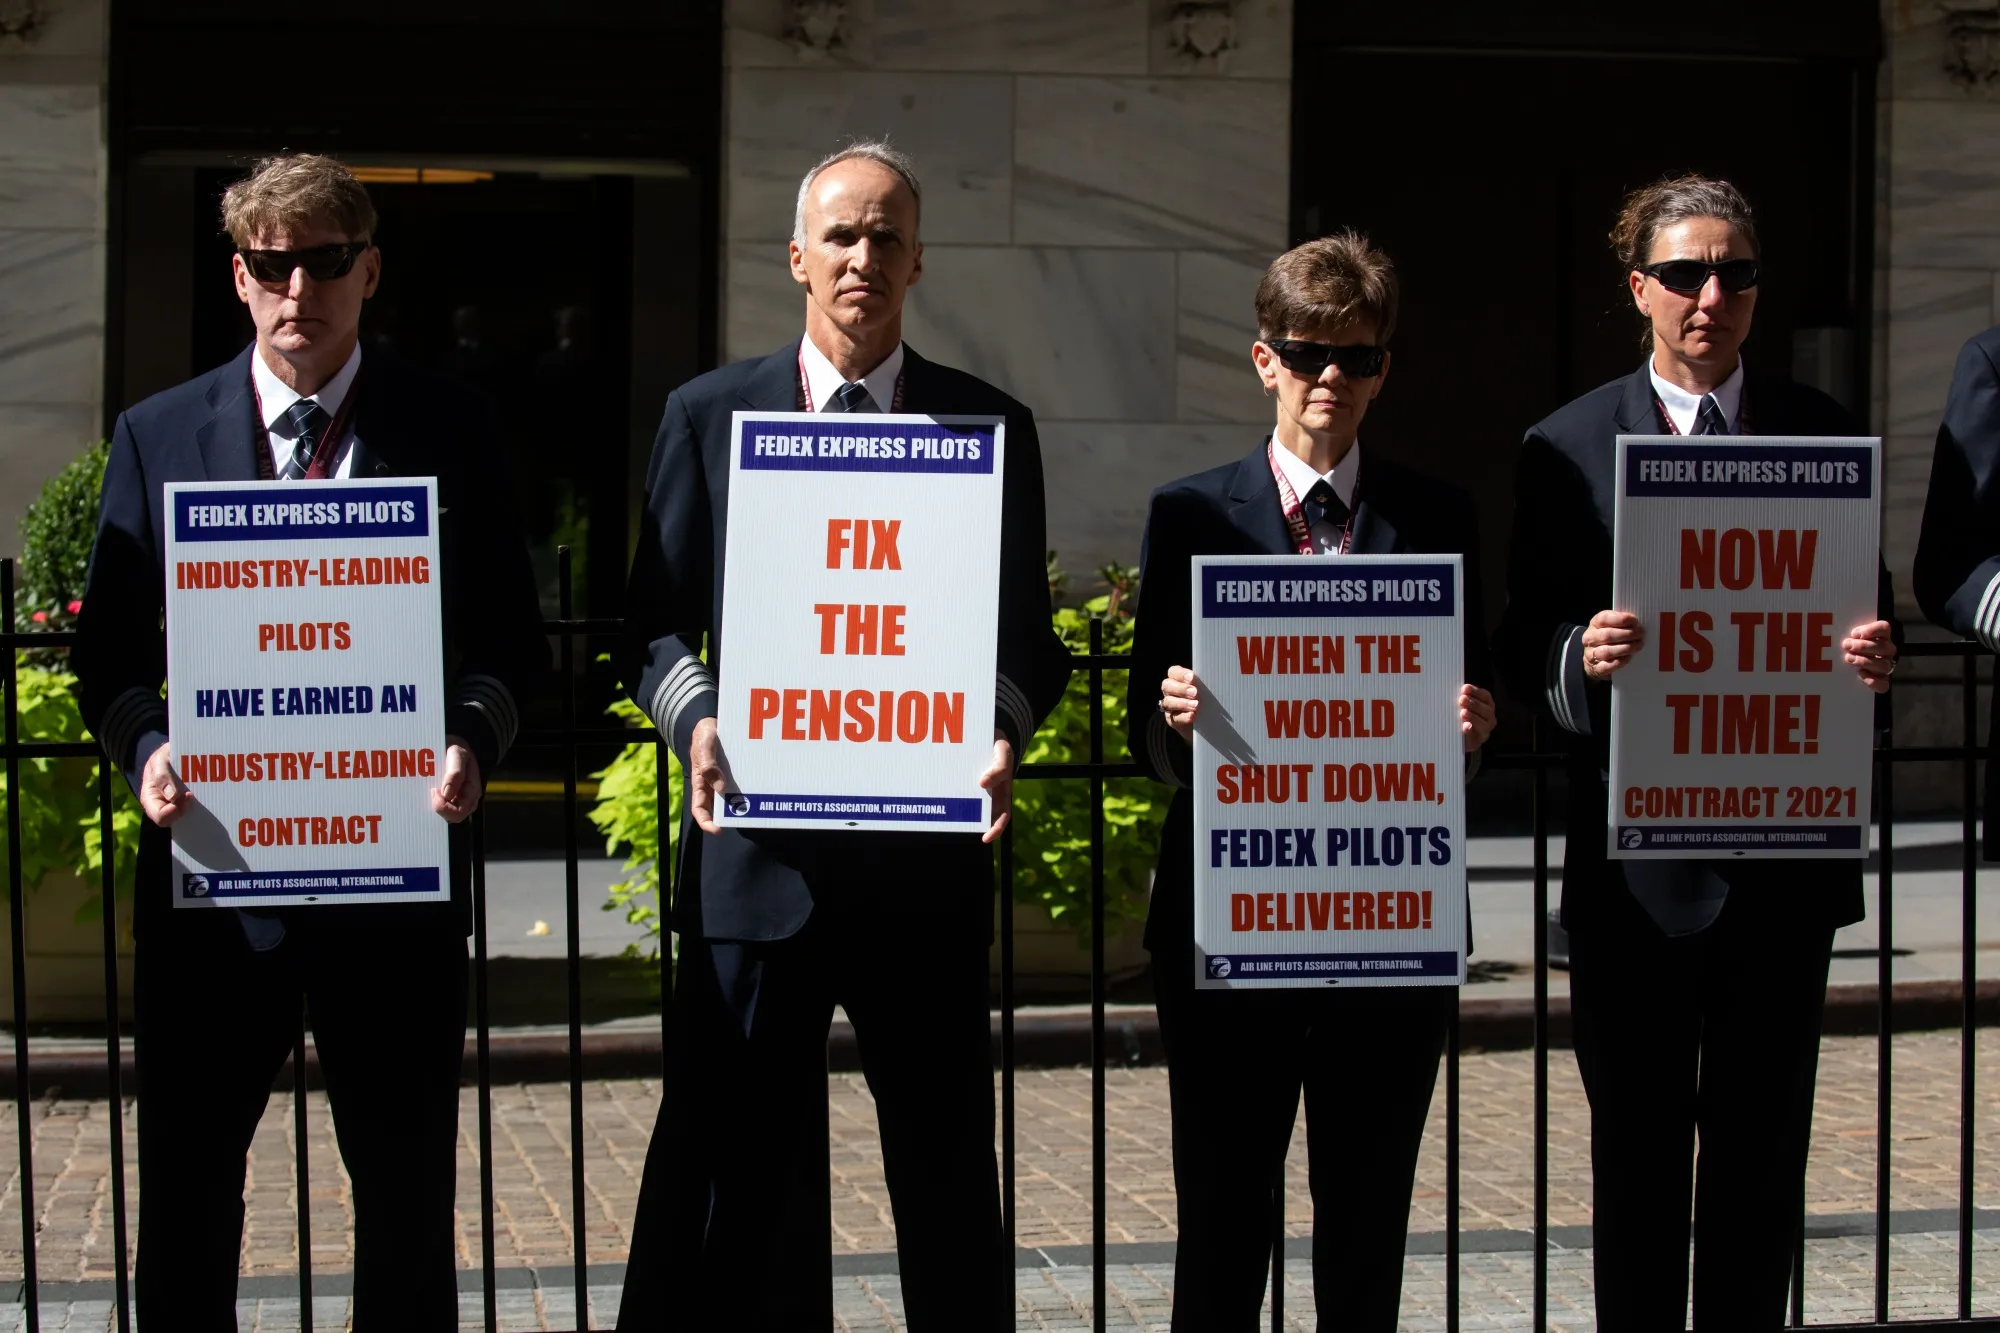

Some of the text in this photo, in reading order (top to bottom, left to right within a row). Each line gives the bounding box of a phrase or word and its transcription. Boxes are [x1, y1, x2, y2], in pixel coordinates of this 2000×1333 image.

[754, 435, 981, 460] FEDEX EXPRESS PILOTS
[1640, 460, 1859, 484] FEDEX EXPRESS PILOTS
[188, 500, 415, 528] FEDEX EXPRESS PILOTS
[1287, 511, 1309, 541] THE
[826, 518, 902, 571] FIX
[1679, 528, 1818, 591] NOW
[176, 555, 430, 590] INDUSTRY-LEADING
[1216, 578, 1441, 603] FEDEX EXPRESS PILOTS
[258, 621, 352, 652] PILOTS
[814, 603, 906, 656] THE
[1658, 610, 1834, 674] IS THE
[1237, 634, 1421, 675] WHEN THE
[196, 684, 417, 718] HAVE EARNED AN
[748, 688, 965, 744] PENSION
[1263, 699, 1395, 739] WORLD
[1665, 693, 1821, 756] TIME!
[180, 747, 436, 783] INDUSTRY-LEADING
[1216, 762, 1445, 805] SHUT DOWN,
[759, 801, 774, 811] AIR
[775, 801, 793, 812] LINE
[794, 802, 823, 812] PILOTS
[882, 803, 946, 815] INTERNATIONAL
[1624, 785, 1857, 819] CONTRACT 2021
[238, 815, 382, 848] CONTRACT
[1210, 825, 1452, 868] FEDEX PILOTS
[1651, 833, 1665, 843] AIR
[1666, 833, 1683, 843] LINE
[1684, 833, 1712, 843] PILOTS
[1767, 832, 1827, 842] INTERNATIONAL
[218, 880, 233, 890] AIR
[234, 879, 252, 890] LINE
[252, 878, 282, 889] PILOTS
[341, 875, 404, 887] INTERNATIONAL
[1230, 890, 1432, 932] DELIVERED!
[1240, 962, 1255, 972] AIR
[1256, 961, 1274, 972] LINE
[1274, 961, 1303, 971] PILOTS
[1361, 959, 1423, 970] INTERNATIONAL
